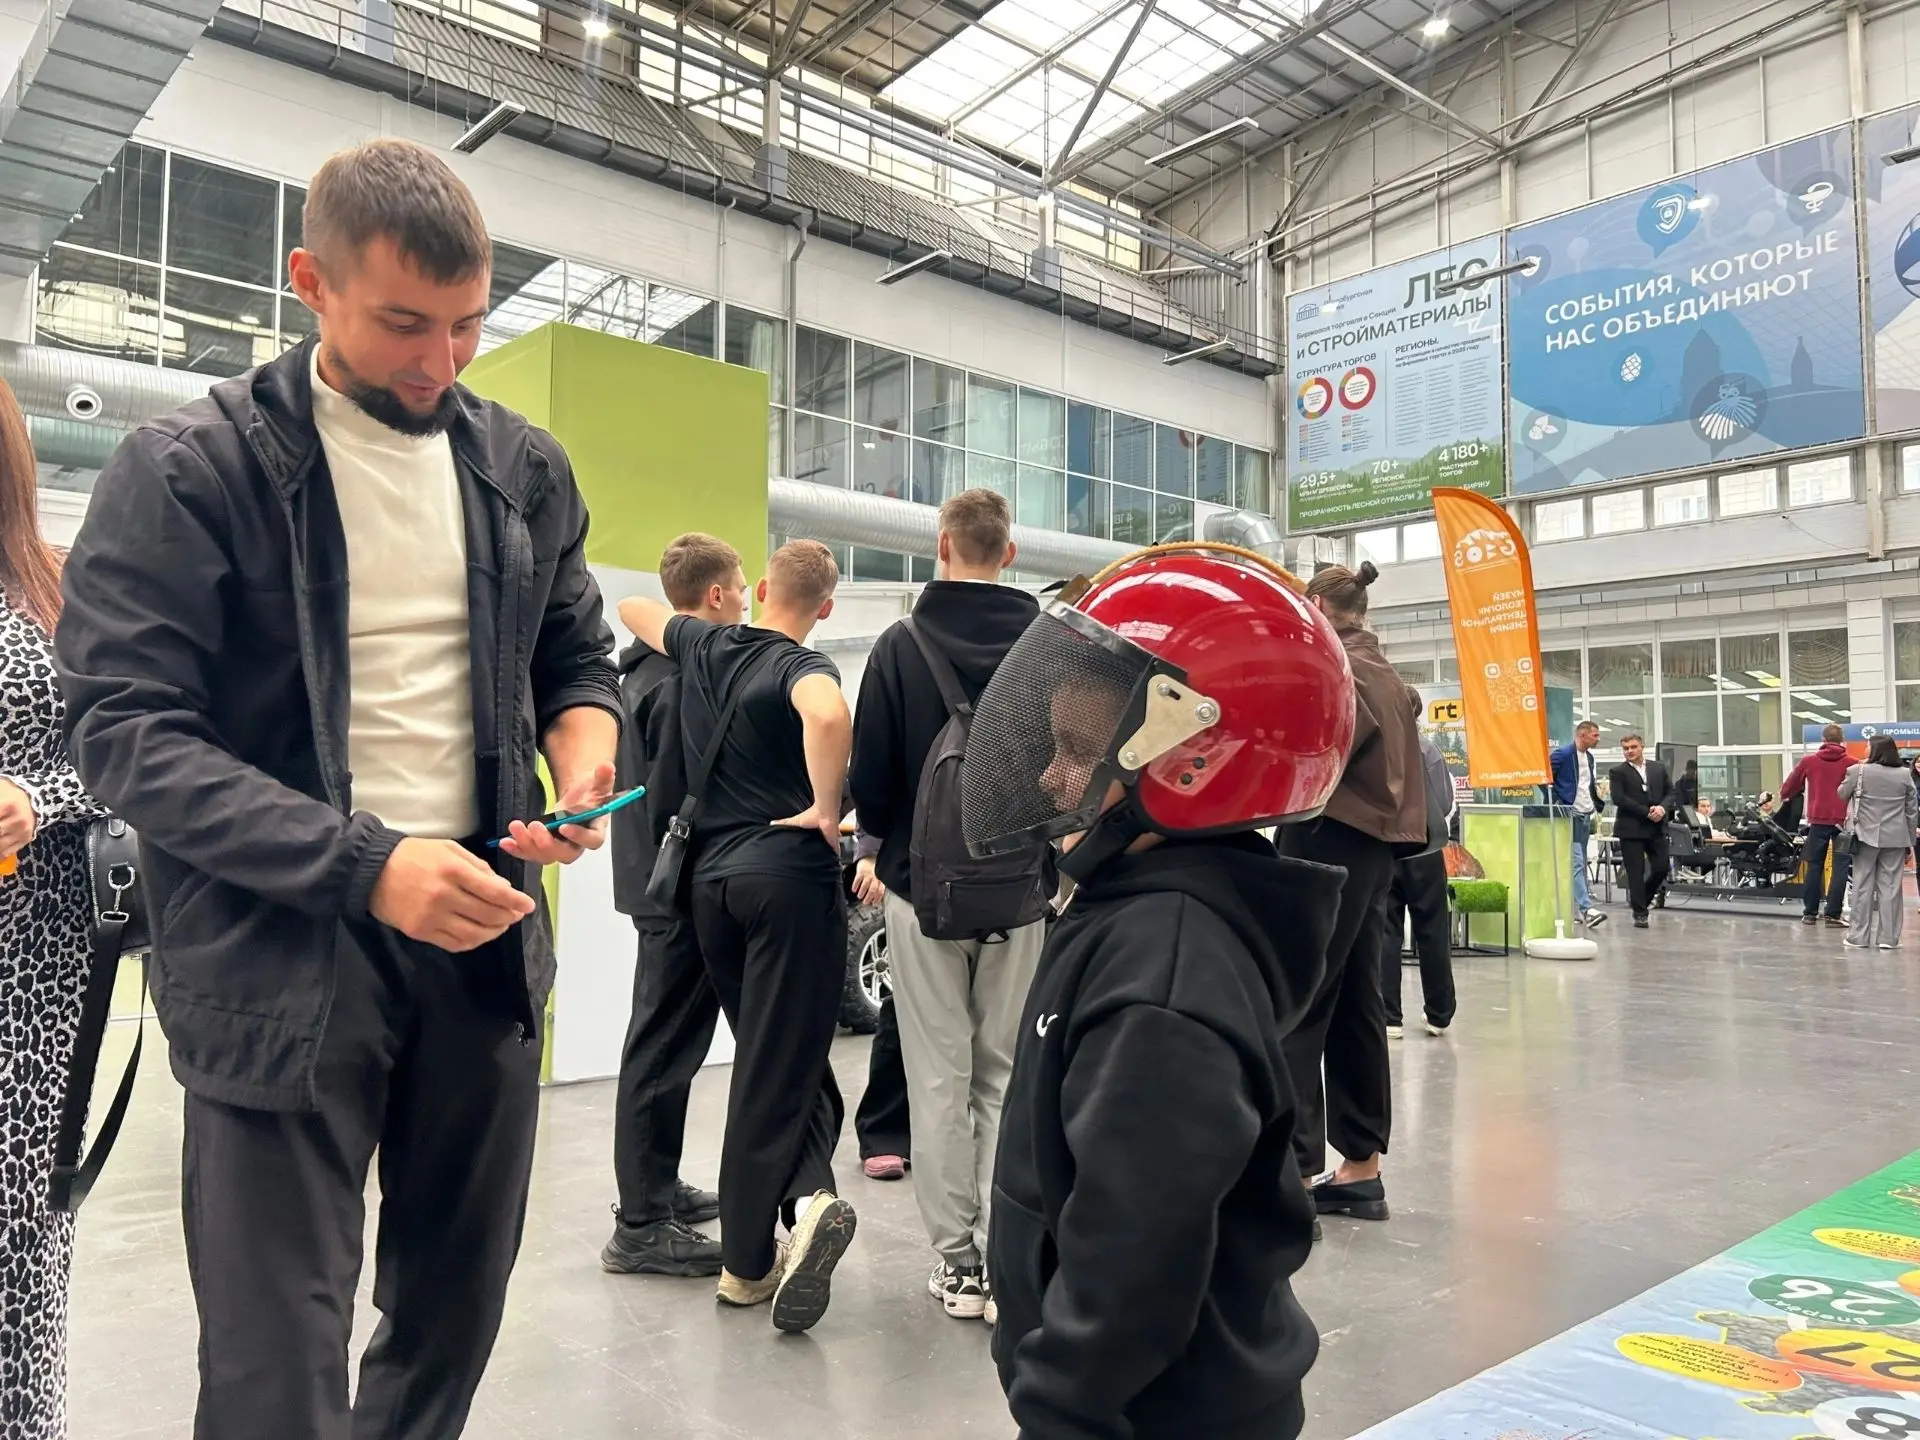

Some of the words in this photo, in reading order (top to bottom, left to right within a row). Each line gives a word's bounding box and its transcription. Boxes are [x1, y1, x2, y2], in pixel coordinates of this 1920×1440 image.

[1403, 258, 1488, 309] ЛЕС
[1545, 274, 1681, 324] СОБЫТИЯ,
[1690, 230, 1839, 287] КОТОРЫЕ
[1545, 324, 1596, 353] НАС
[1602, 268, 1814, 339] ОБЪЕДИНЯЮТ
[1297, 349, 1305, 360] и
[1308, 294, 1491, 356] СТРОЙМАТЕРИАЛЫ
[1296, 362, 1342, 379] СТРУКТУРА
[1344, 352, 1377, 367] ТОРГОВ
[1299, 471, 1336, 489] 29,5+
[1371, 459, 1399, 475] 70+
[1439, 469, 1463, 478] ТОРГОВ
[1463, 480, 1491, 490] БИРЖУ
[1299, 504, 1351, 518] ПРОЗРАЧНОСТЬ
[1352, 498, 1381, 509] ЛЕСНОЙ
[1381, 492, 1415, 505] ОТРАСЛИ
[1434, 703, 1457, 719] rt
[1778, 1279, 1900, 1315] 26
